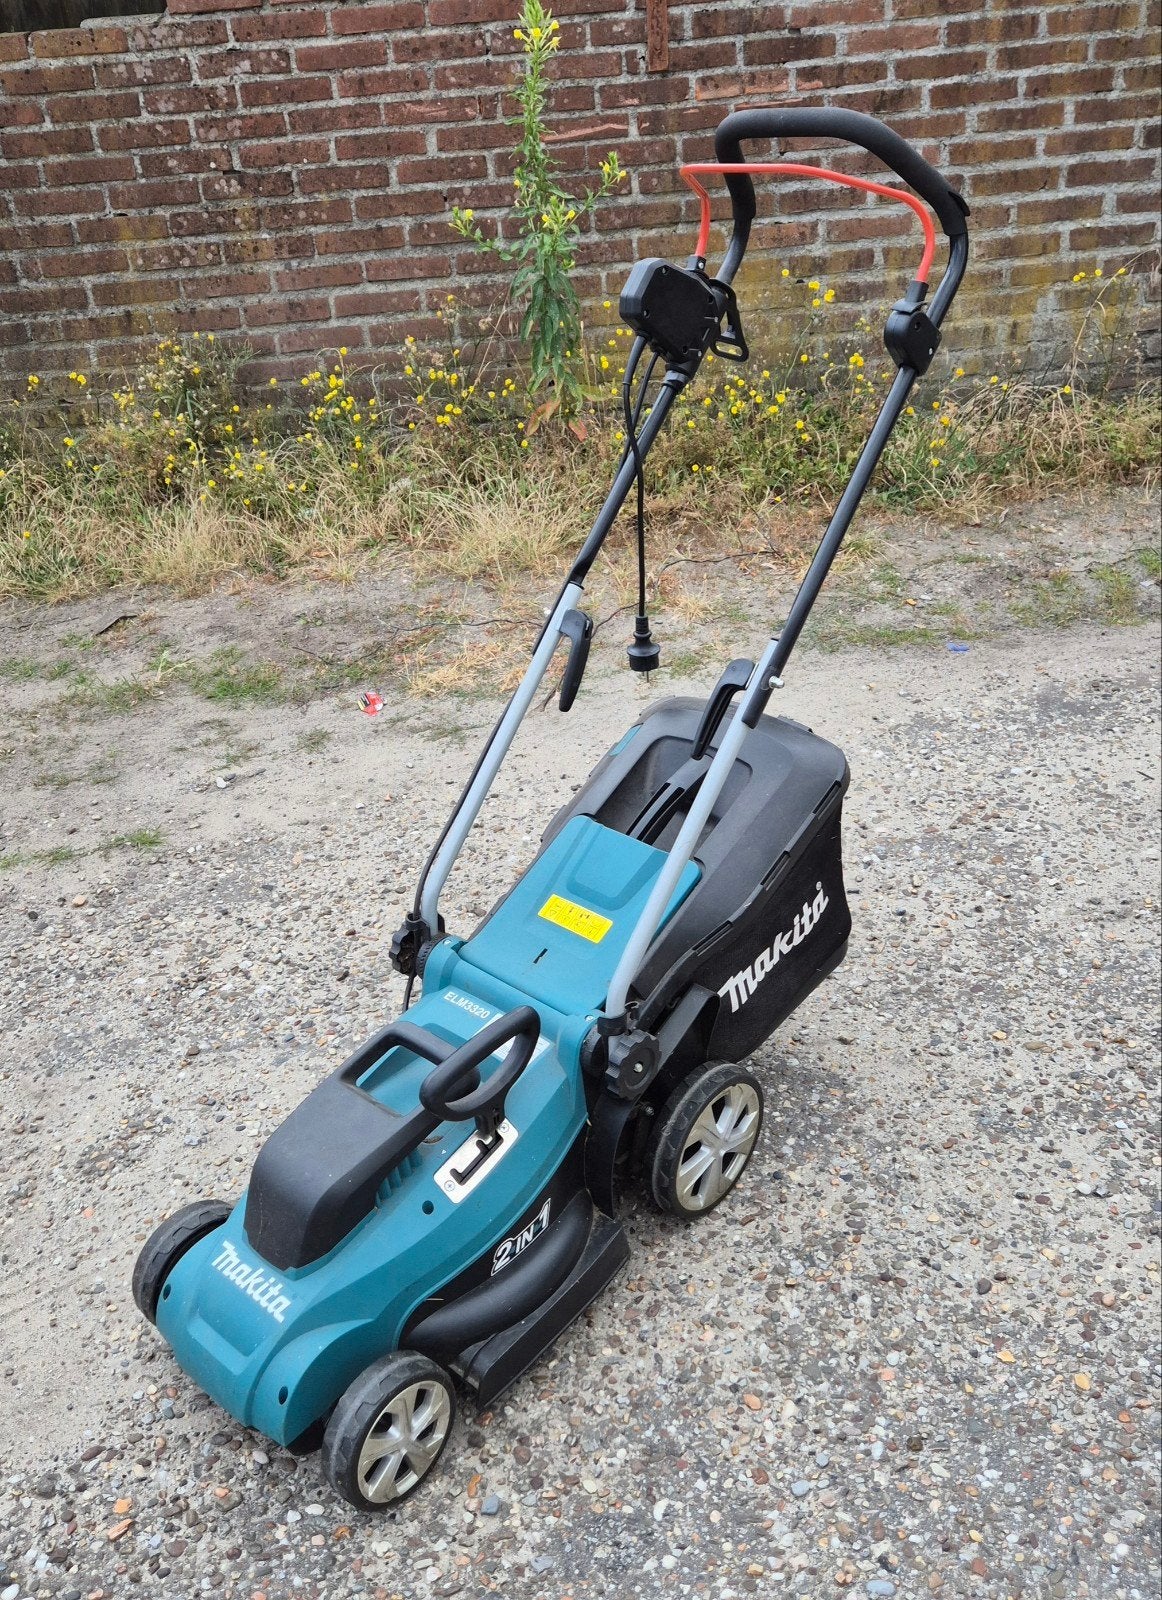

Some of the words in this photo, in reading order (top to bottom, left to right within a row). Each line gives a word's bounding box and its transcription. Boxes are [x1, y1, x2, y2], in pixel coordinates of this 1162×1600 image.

[717, 888, 829, 1013] Makita
[443, 991, 491, 1019] ELM3320
[494, 1241, 512, 1271] 2
[515, 1223, 535, 1254] IN
[539, 1203, 549, 1228] 1
[211, 1240, 291, 1323] Makita
